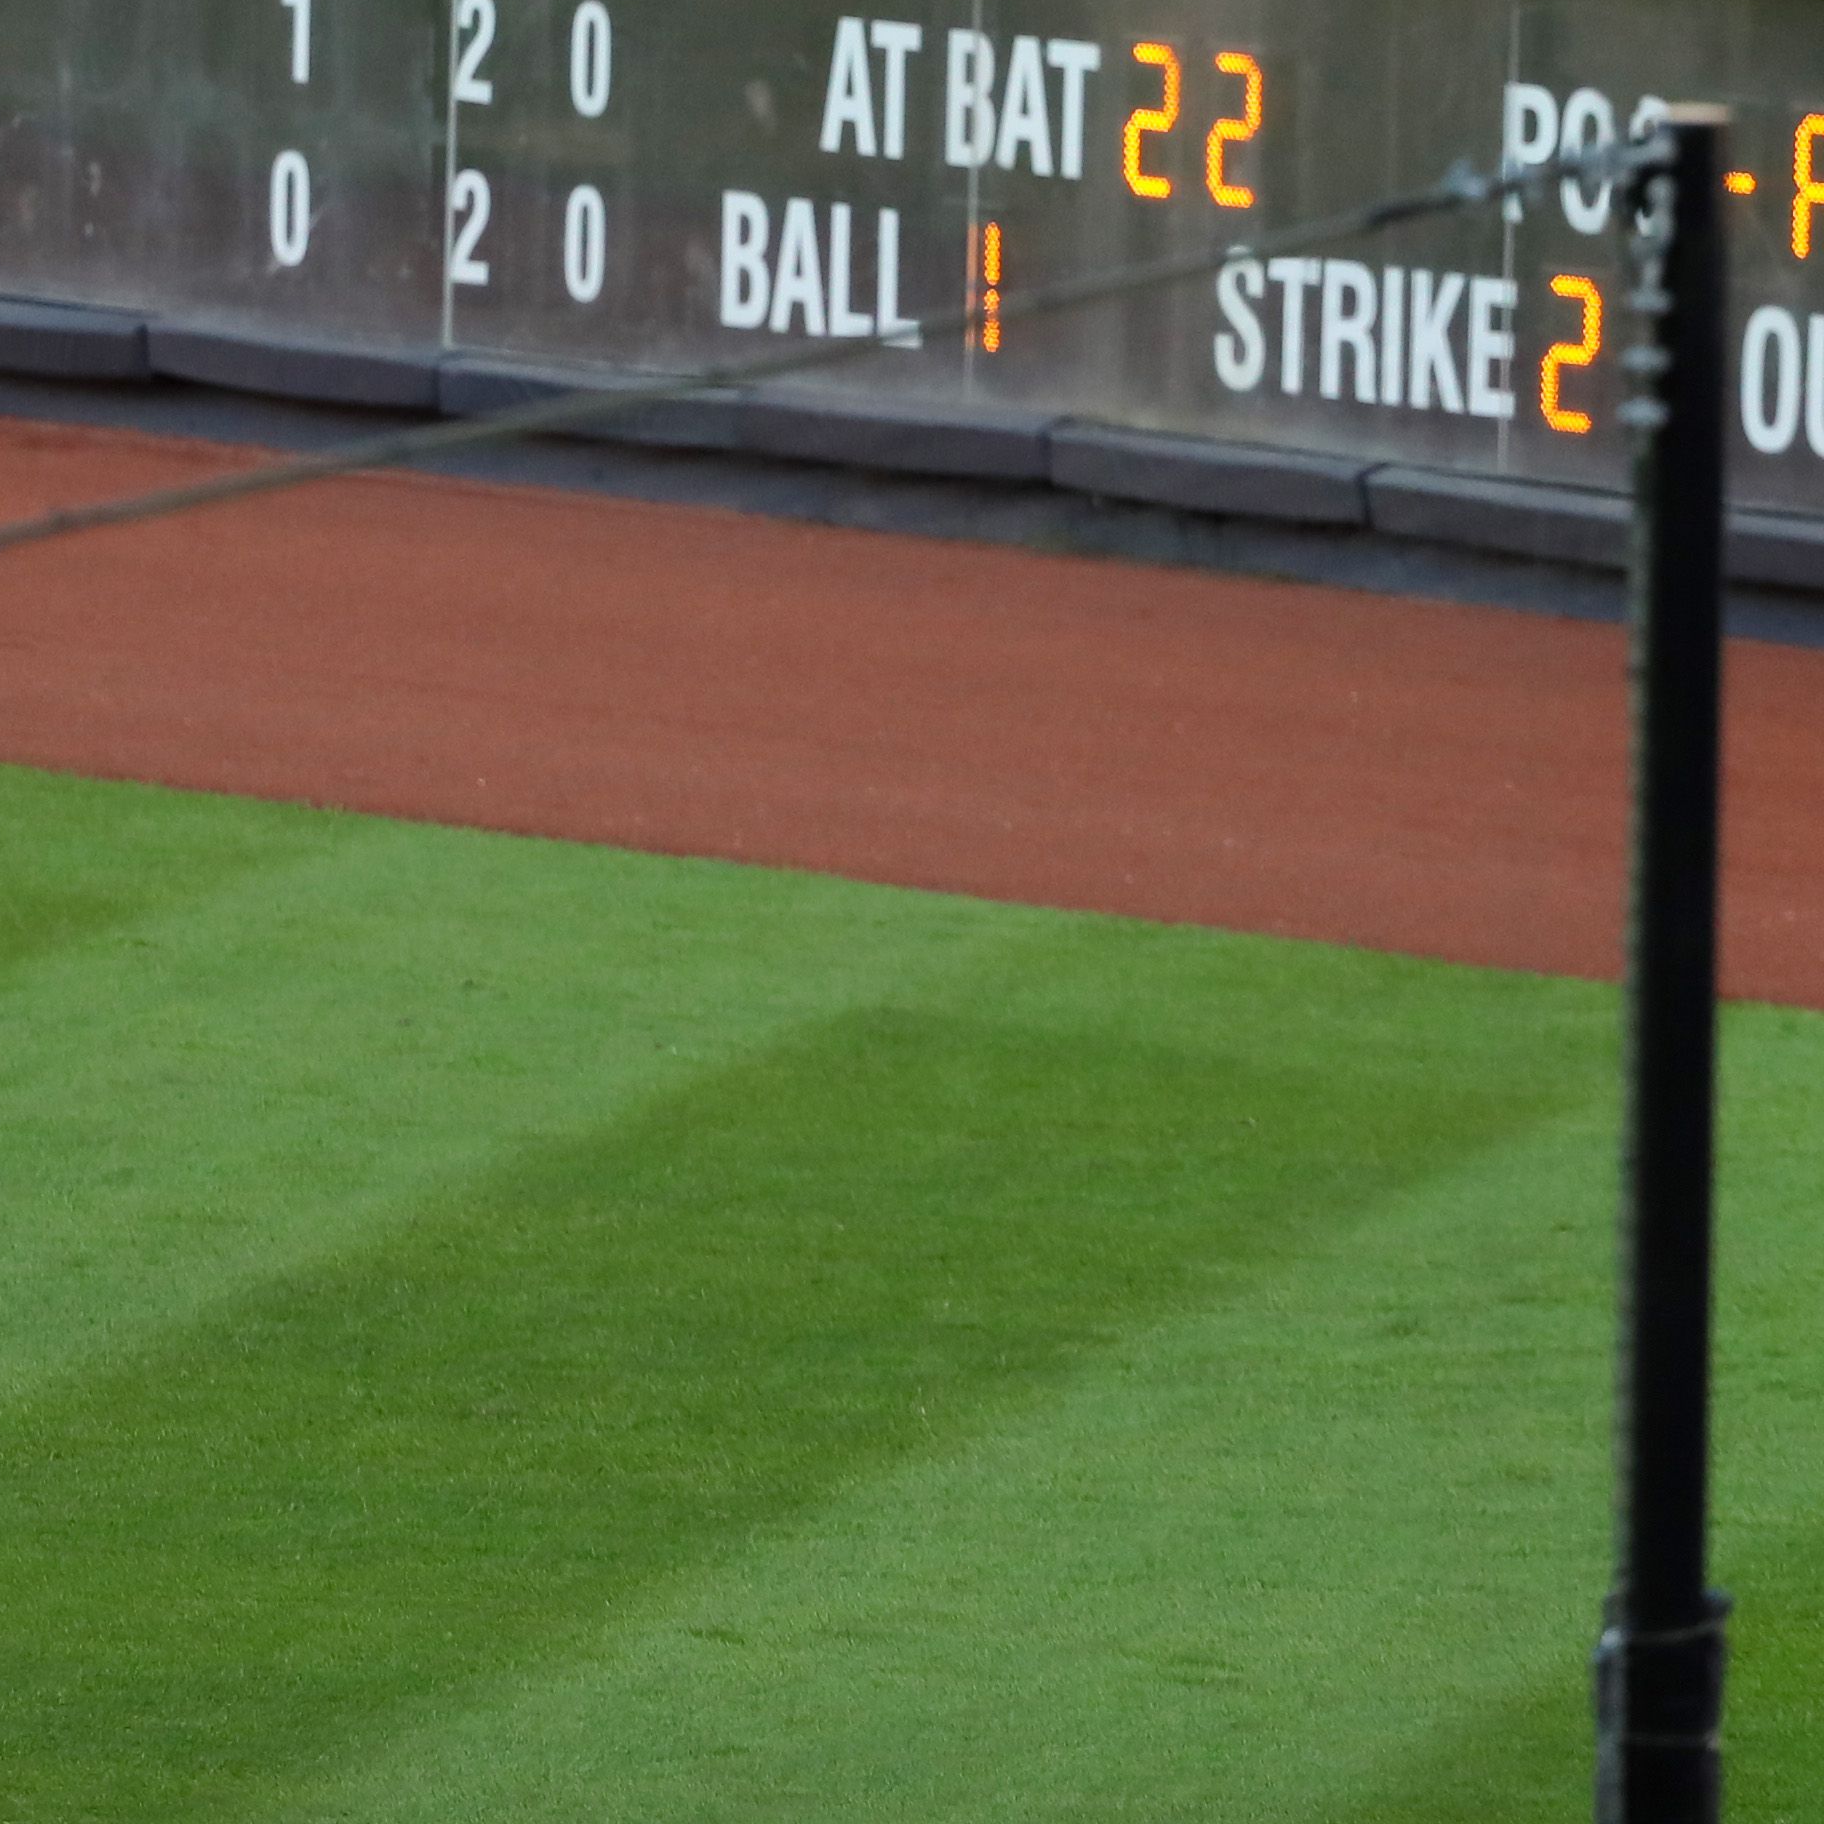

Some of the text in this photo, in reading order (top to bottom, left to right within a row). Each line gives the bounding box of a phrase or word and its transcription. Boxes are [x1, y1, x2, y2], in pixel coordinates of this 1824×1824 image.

[571, 0, 611, 118] 0
[819, 16, 1263, 209] AT BAT 22
[270, 150, 310, 266] 0
[451, 170, 491, 286] 2
[565, 184, 605, 303] 0
[720, 190, 1001, 353] BALL 1
[1213, 246, 1604, 435] STRIKE 2
